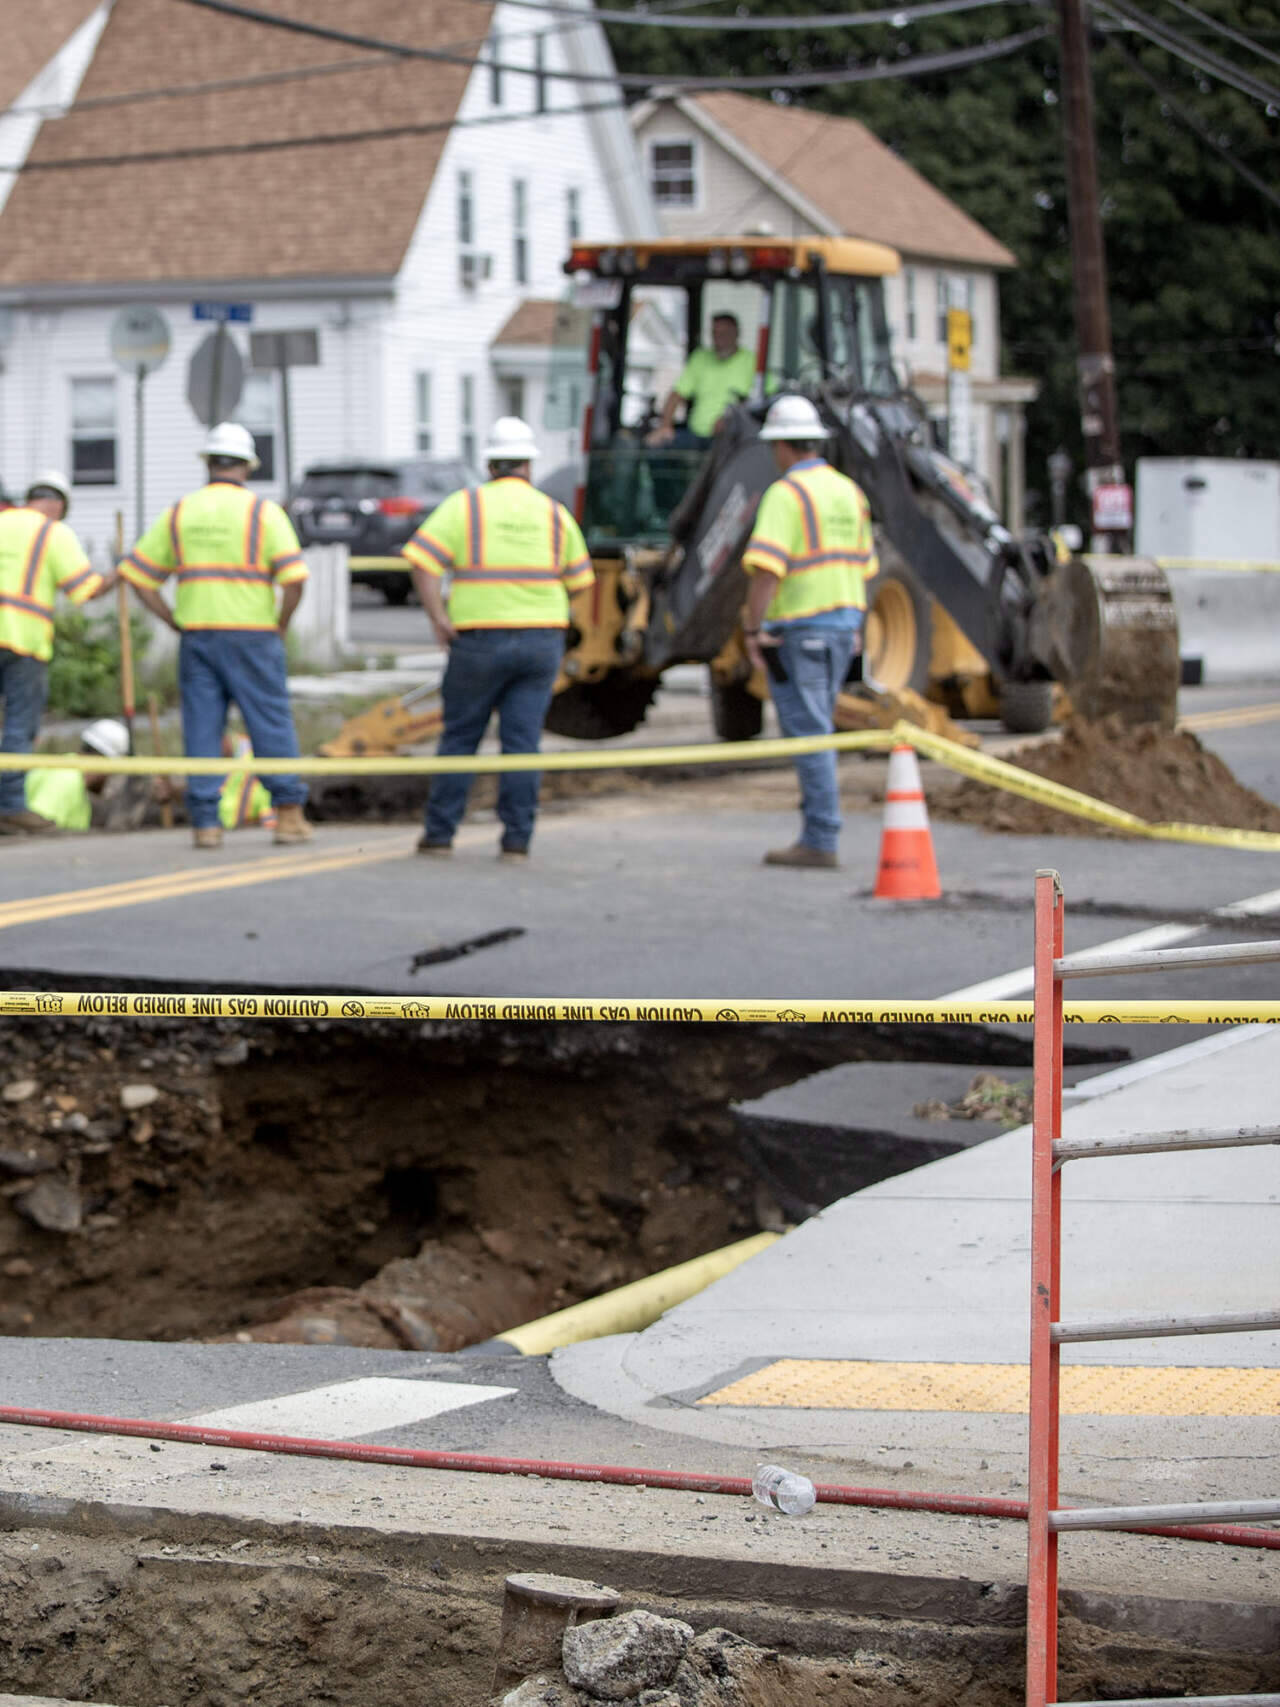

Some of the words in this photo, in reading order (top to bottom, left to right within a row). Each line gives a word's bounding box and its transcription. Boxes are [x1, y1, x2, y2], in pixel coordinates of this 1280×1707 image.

[36, 998, 63, 1013] 811
[78, 994, 128, 1013] BELOW
[133, 996, 186, 1014] BURIED
[192, 997, 222, 1015] LINE
[229, 998, 258, 1015] GAS
[264, 999, 329, 1017] CAUTION
[446, 1003, 496, 1019] BELOW
[502, 1004, 556, 1020] BURIED
[562, 1005, 593, 1020] LINE
[599, 1006, 630, 1020] GAS
[636, 1007, 703, 1021] CAUTION
